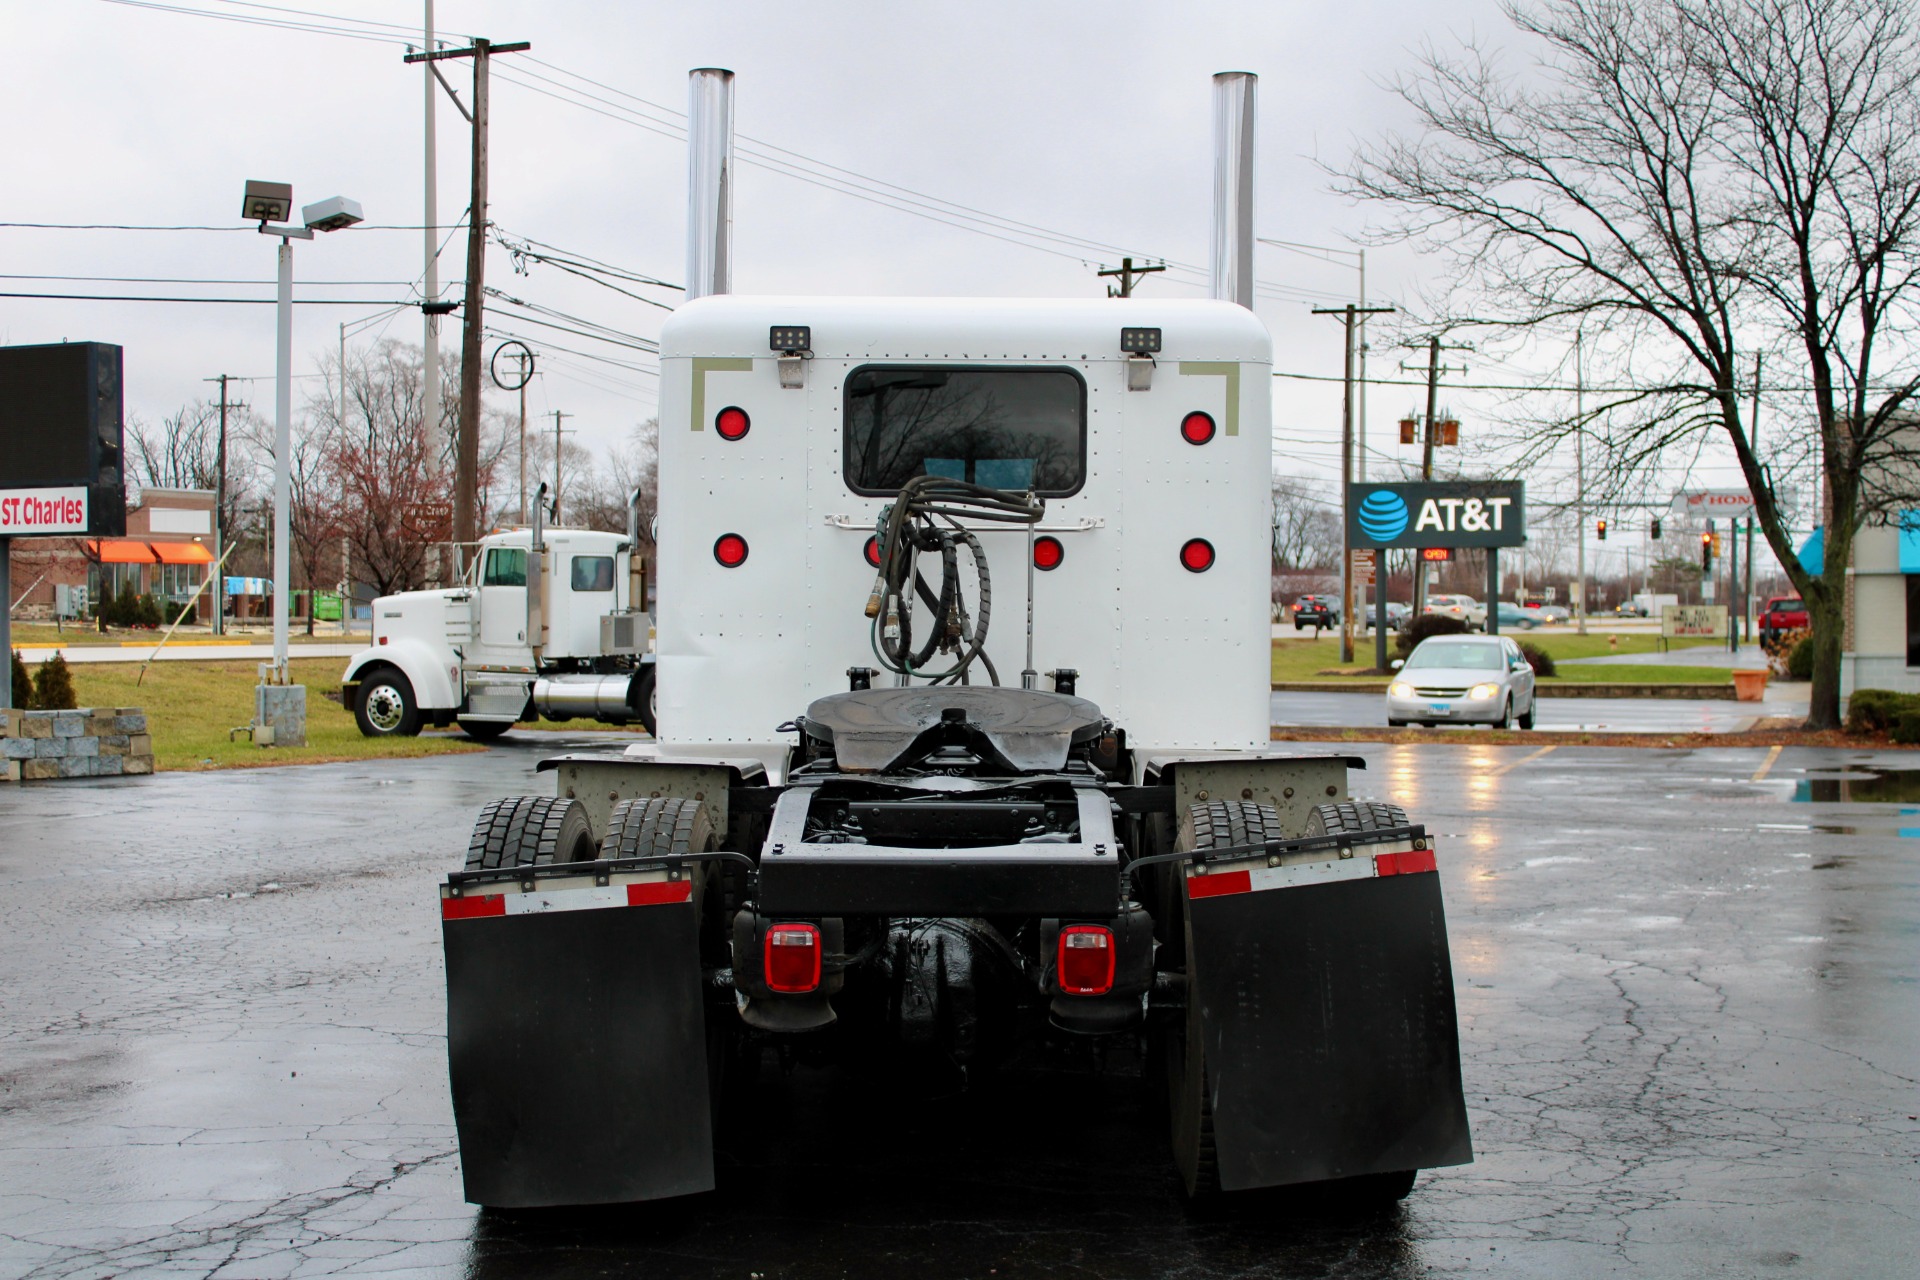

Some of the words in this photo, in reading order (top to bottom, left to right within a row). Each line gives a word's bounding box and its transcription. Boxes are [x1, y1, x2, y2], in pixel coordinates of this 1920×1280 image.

[2, 498, 21, 525] ST.
[23, 496, 82, 525] Charles
[1415, 497, 1511, 532] AT&T
[1424, 549, 1448, 560] OPEN
